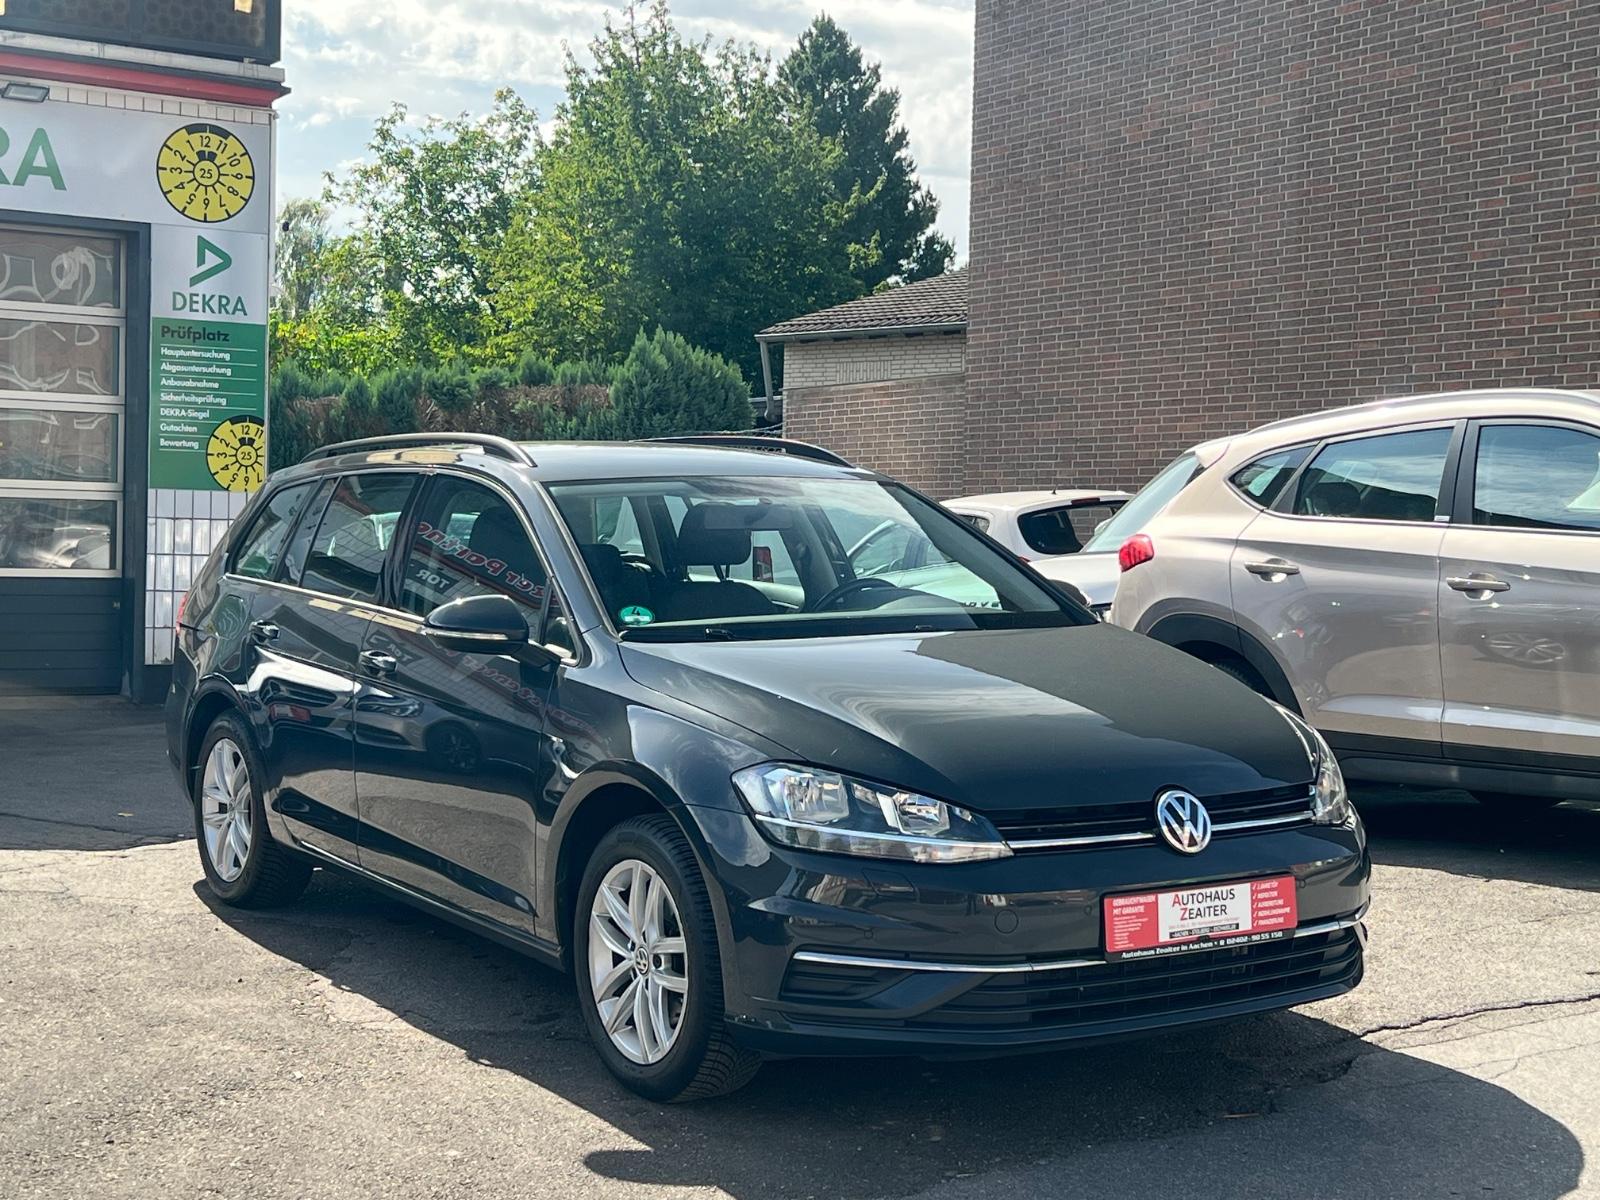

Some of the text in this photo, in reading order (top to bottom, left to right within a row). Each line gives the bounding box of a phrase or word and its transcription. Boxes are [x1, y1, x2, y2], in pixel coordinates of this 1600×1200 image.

[186, 140, 196, 152] 1
[199, 135, 211, 148] 12
[215, 139, 229, 153] 11
[173, 150, 187, 162] 2
[227, 152, 242, 167] 10
[169, 166, 183, 175] 3
[199, 168, 213, 179] 25
[231, 172, 244, 180] 9
[174, 181, 187, 191] 4
[227, 186, 240, 197] 8
[185, 193, 197, 205] 5
[203, 197, 209, 210] 6
[218, 194, 227, 207] 7
[172, 291, 248, 316] DEKRA
[160, 325, 230, 343] Prüfplatz
[160, 346, 231, 361] Hauptuntersuchung
[160, 362, 232, 376] Abgasuntersuchung
[160, 377, 219, 388] Anbauabnahme
[160, 392, 227, 405] Sicherheitsprüfung
[160, 408, 210, 419] DEKRA-Siegel
[160, 423, 198, 433] Gutachten
[230, 429, 238, 439] 1
[241, 424, 251, 435] 12
[254, 427, 264, 439] 11
[159, 438, 199, 449] Bewertung
[219, 438, 231, 448] 2
[240, 451, 252, 460] 25
[229, 472, 239, 483] 5
[243, 476, 250, 486] 6
[1171, 888, 1236, 908] AUTOHAUS
[1180, 904, 1228, 921] ZEAITER
